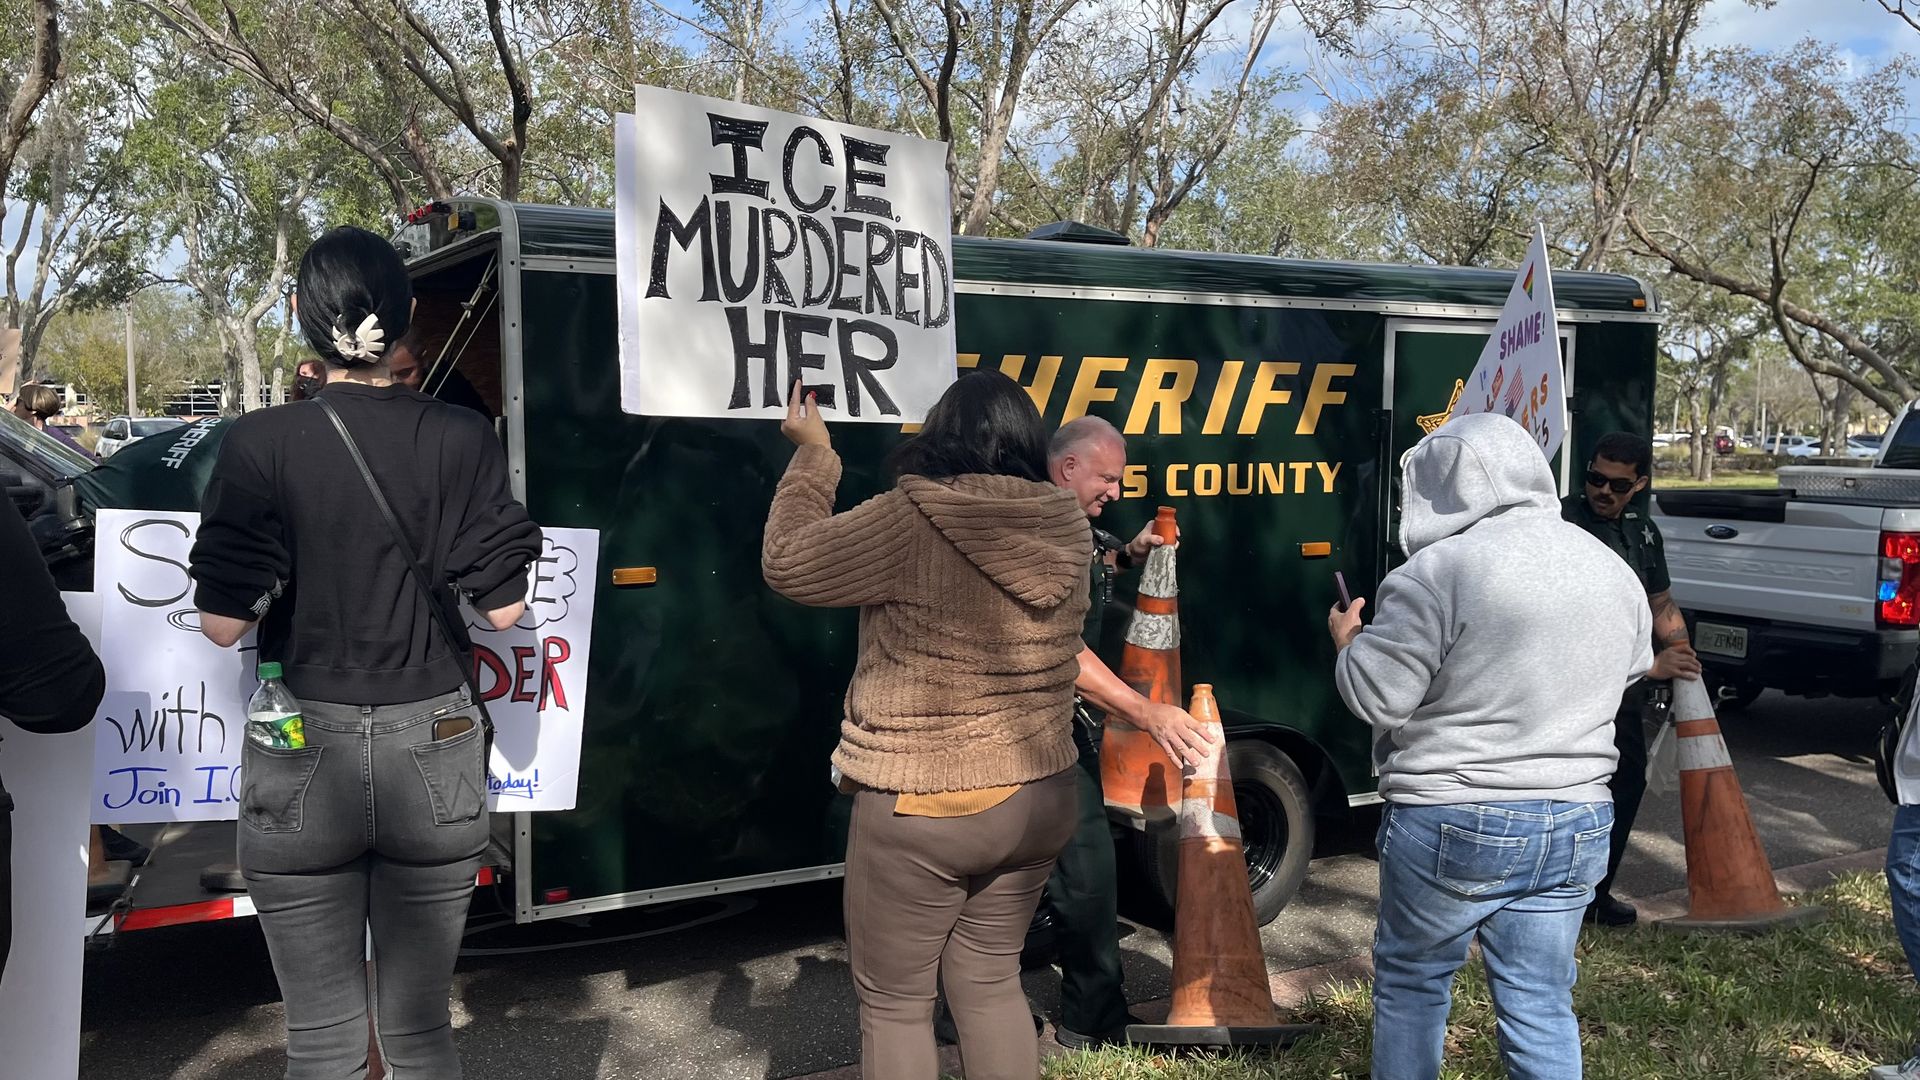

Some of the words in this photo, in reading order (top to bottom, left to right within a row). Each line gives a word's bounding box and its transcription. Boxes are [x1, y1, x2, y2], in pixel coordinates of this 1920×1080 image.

[644, 195, 949, 329] MURDERED
[725, 306, 901, 417] HER
[1500, 311, 1546, 360] SHAME!
[900, 354, 1357, 434] HERIFF
[161, 417, 222, 469] SHERIFF
[1166, 462, 1342, 496] COUNTY
[105, 681, 226, 755] with
[103, 767, 181, 809] Join
[487, 768, 539, 799] today!
